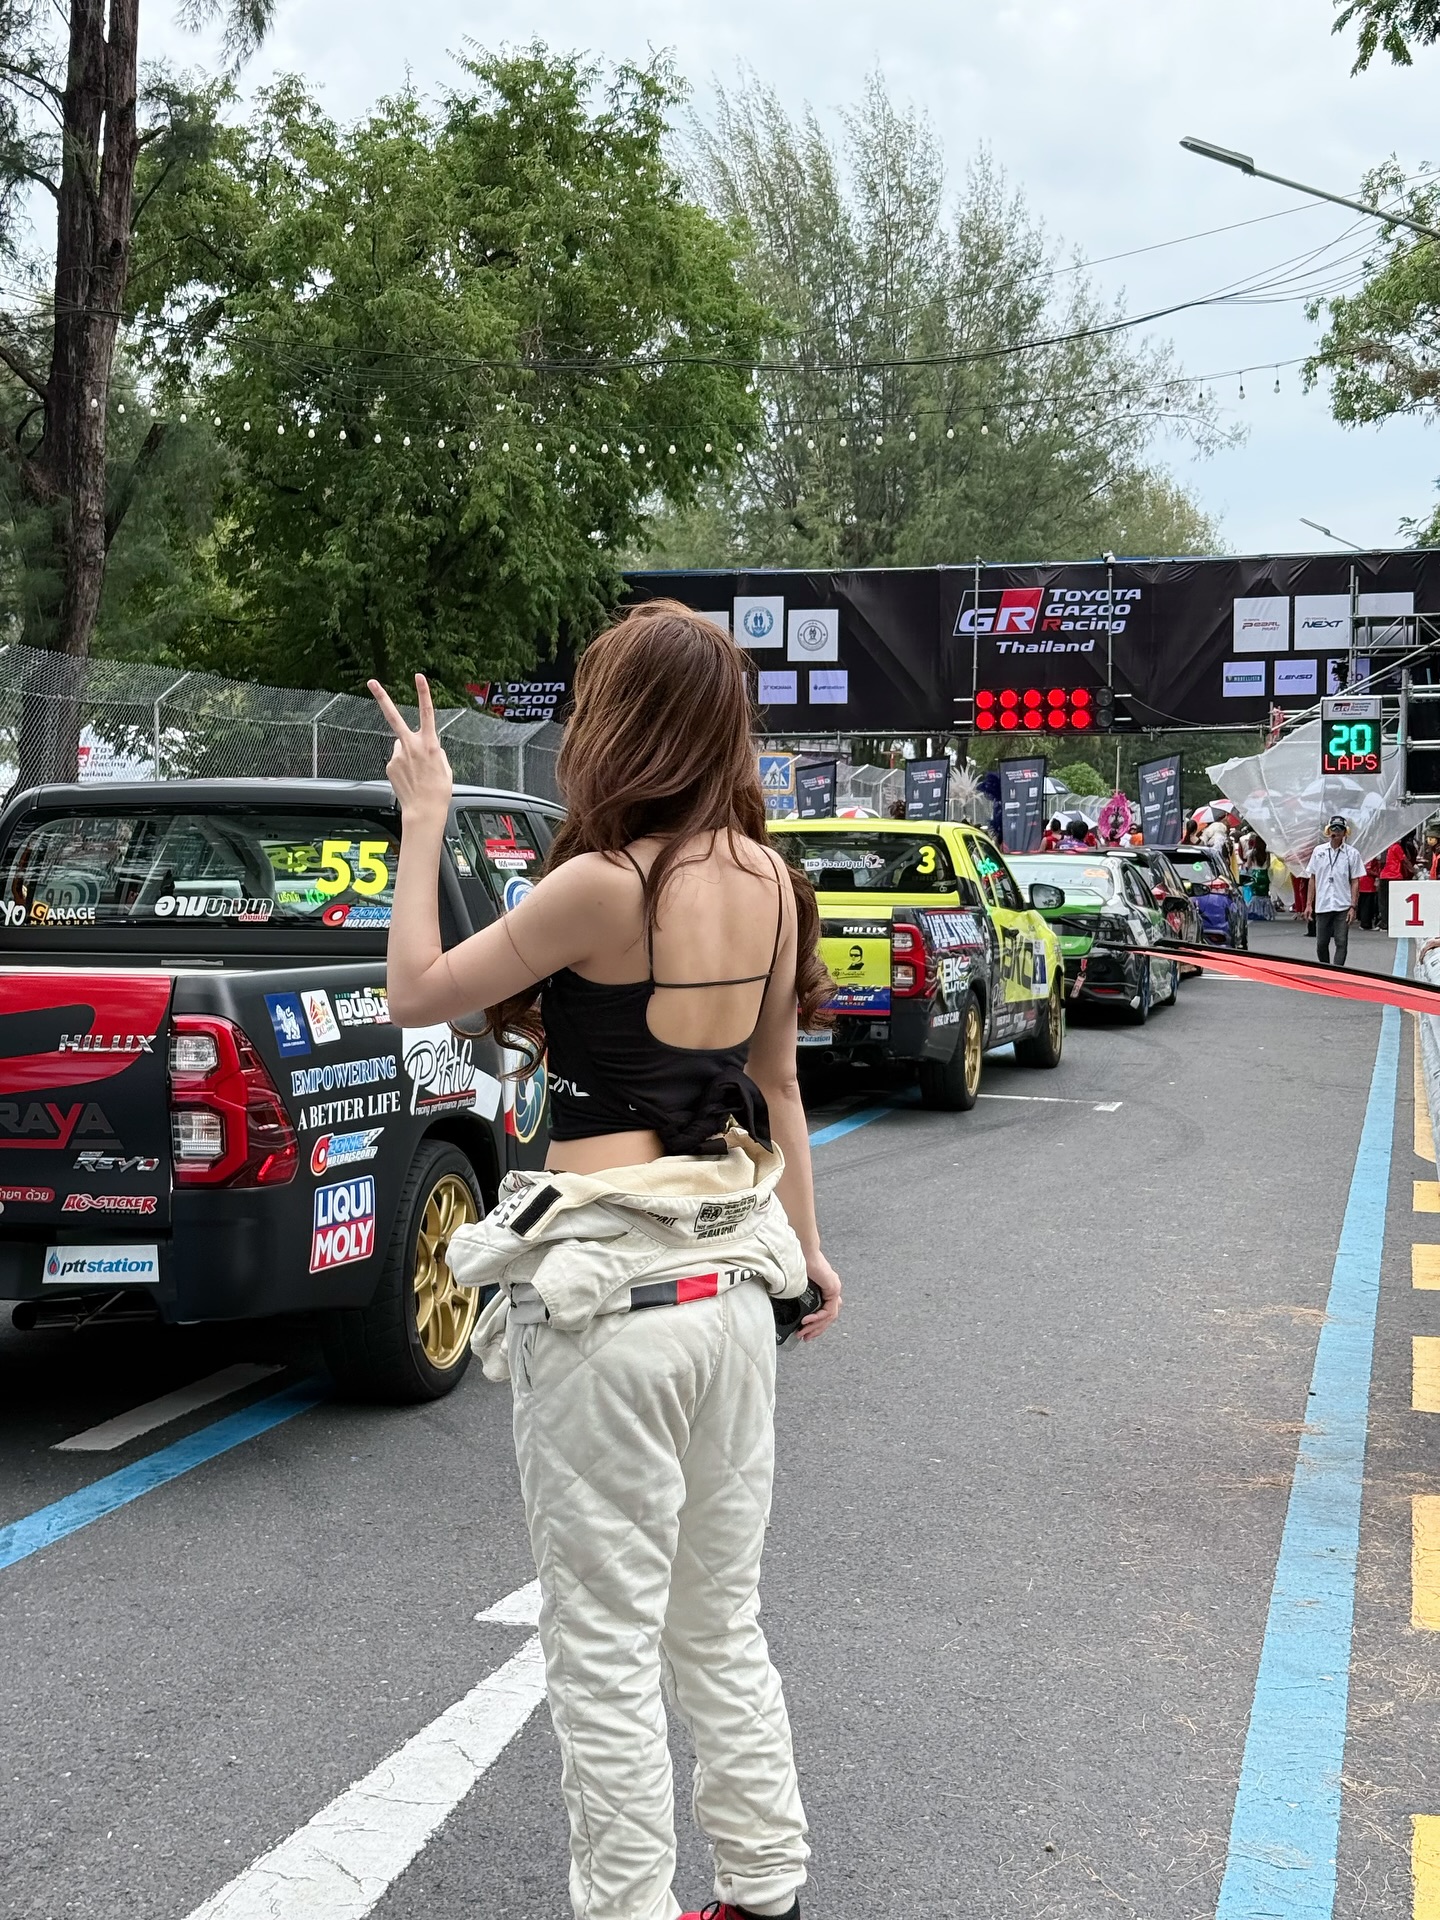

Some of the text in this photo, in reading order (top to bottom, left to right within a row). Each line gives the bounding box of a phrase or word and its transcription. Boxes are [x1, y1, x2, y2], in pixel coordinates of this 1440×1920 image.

[1049, 588, 1141, 602] TOYOTA
[958, 607, 1035, 632] GR
[1045, 604, 1131, 617] GAZOO
[1041, 618, 1127, 634] Racing
[1301, 620, 1344, 628] NEXT
[996, 640, 1095, 654] Thailand
[491, 694, 558, 705] GAZOO
[491, 706, 554, 720] Racing
[1329, 724, 1372, 757] 20
[1325, 753, 1378, 771] LAPS
[315, 839, 390, 897] 55
[915, 845, 936, 874] 3
[30, 901, 96, 920] GARAGE
[1405, 893, 1424, 926] 1
[842, 927, 887, 936] HILUX
[58, 1034, 157, 1053] HILUX
[291, 1055, 397, 1097] EMPOWERING
[297, 1090, 400, 1131] A BETTER LIFE
[415, 1096, 476, 1116] racing performance products
[327, 1147, 376, 1167] MOTORSPORT
[317, 1181, 372, 1227] LIQUI
[313, 1219, 373, 1268] MOLY
